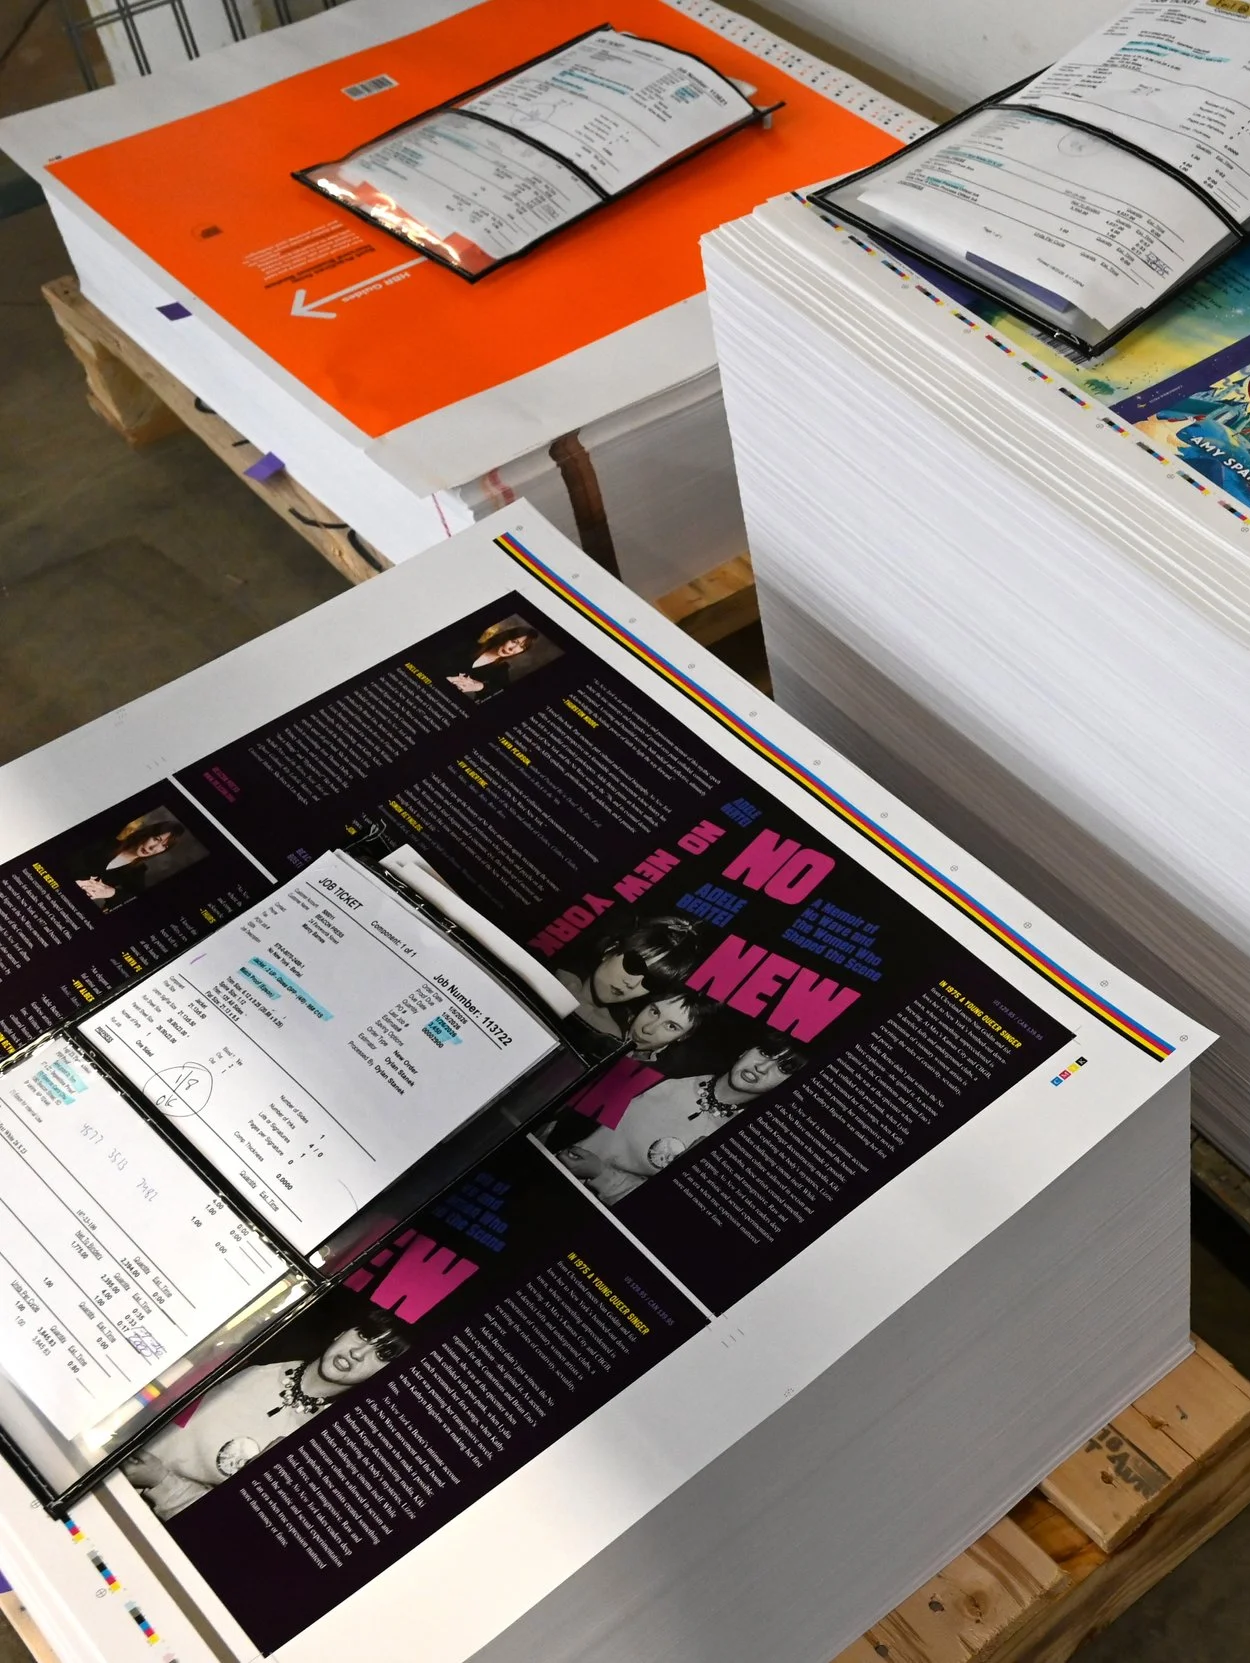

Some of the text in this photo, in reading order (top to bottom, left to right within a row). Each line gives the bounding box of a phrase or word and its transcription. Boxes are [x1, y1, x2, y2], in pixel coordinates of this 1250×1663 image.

[1190, 435, 1225, 459] AMY
[720, 803, 752, 828] BERTEI
[734, 797, 763, 821] ADELE
[721, 828, 836, 905] NO
[318, 876, 362, 910] JOB TICKET
[526, 819, 727, 958] NO NEW YORK
[694, 882, 749, 914] ADELE
[675, 893, 735, 928] BERTEI
[823, 901, 867, 928] Memoir
[369, 920, 402, 946] Component:
[811, 926, 857, 953] Women
[855, 946, 883, 966] Who
[819, 914, 855, 938] Wave
[853, 933, 877, 949] and
[781, 928, 824, 956] Shaped
[844, 957, 883, 983] Scene
[684, 933, 862, 1044] NEW
[432, 973, 513, 1045] Job Number: 113722
[944, 985, 961, 998] 1975
[963, 1000, 983, 1017] YOUNG
[980, 1015, 1002, 1031] QUEER
[999, 1030, 1021, 1048] SINGER
[383, 1057, 415, 1086] Dylan Stanek
[572, 1259, 590, 1274] 1975
[590, 1277, 612, 1297] YOUNG
[608, 1295, 630, 1315] QUEER
[626, 1313, 649, 1335] SINGER
